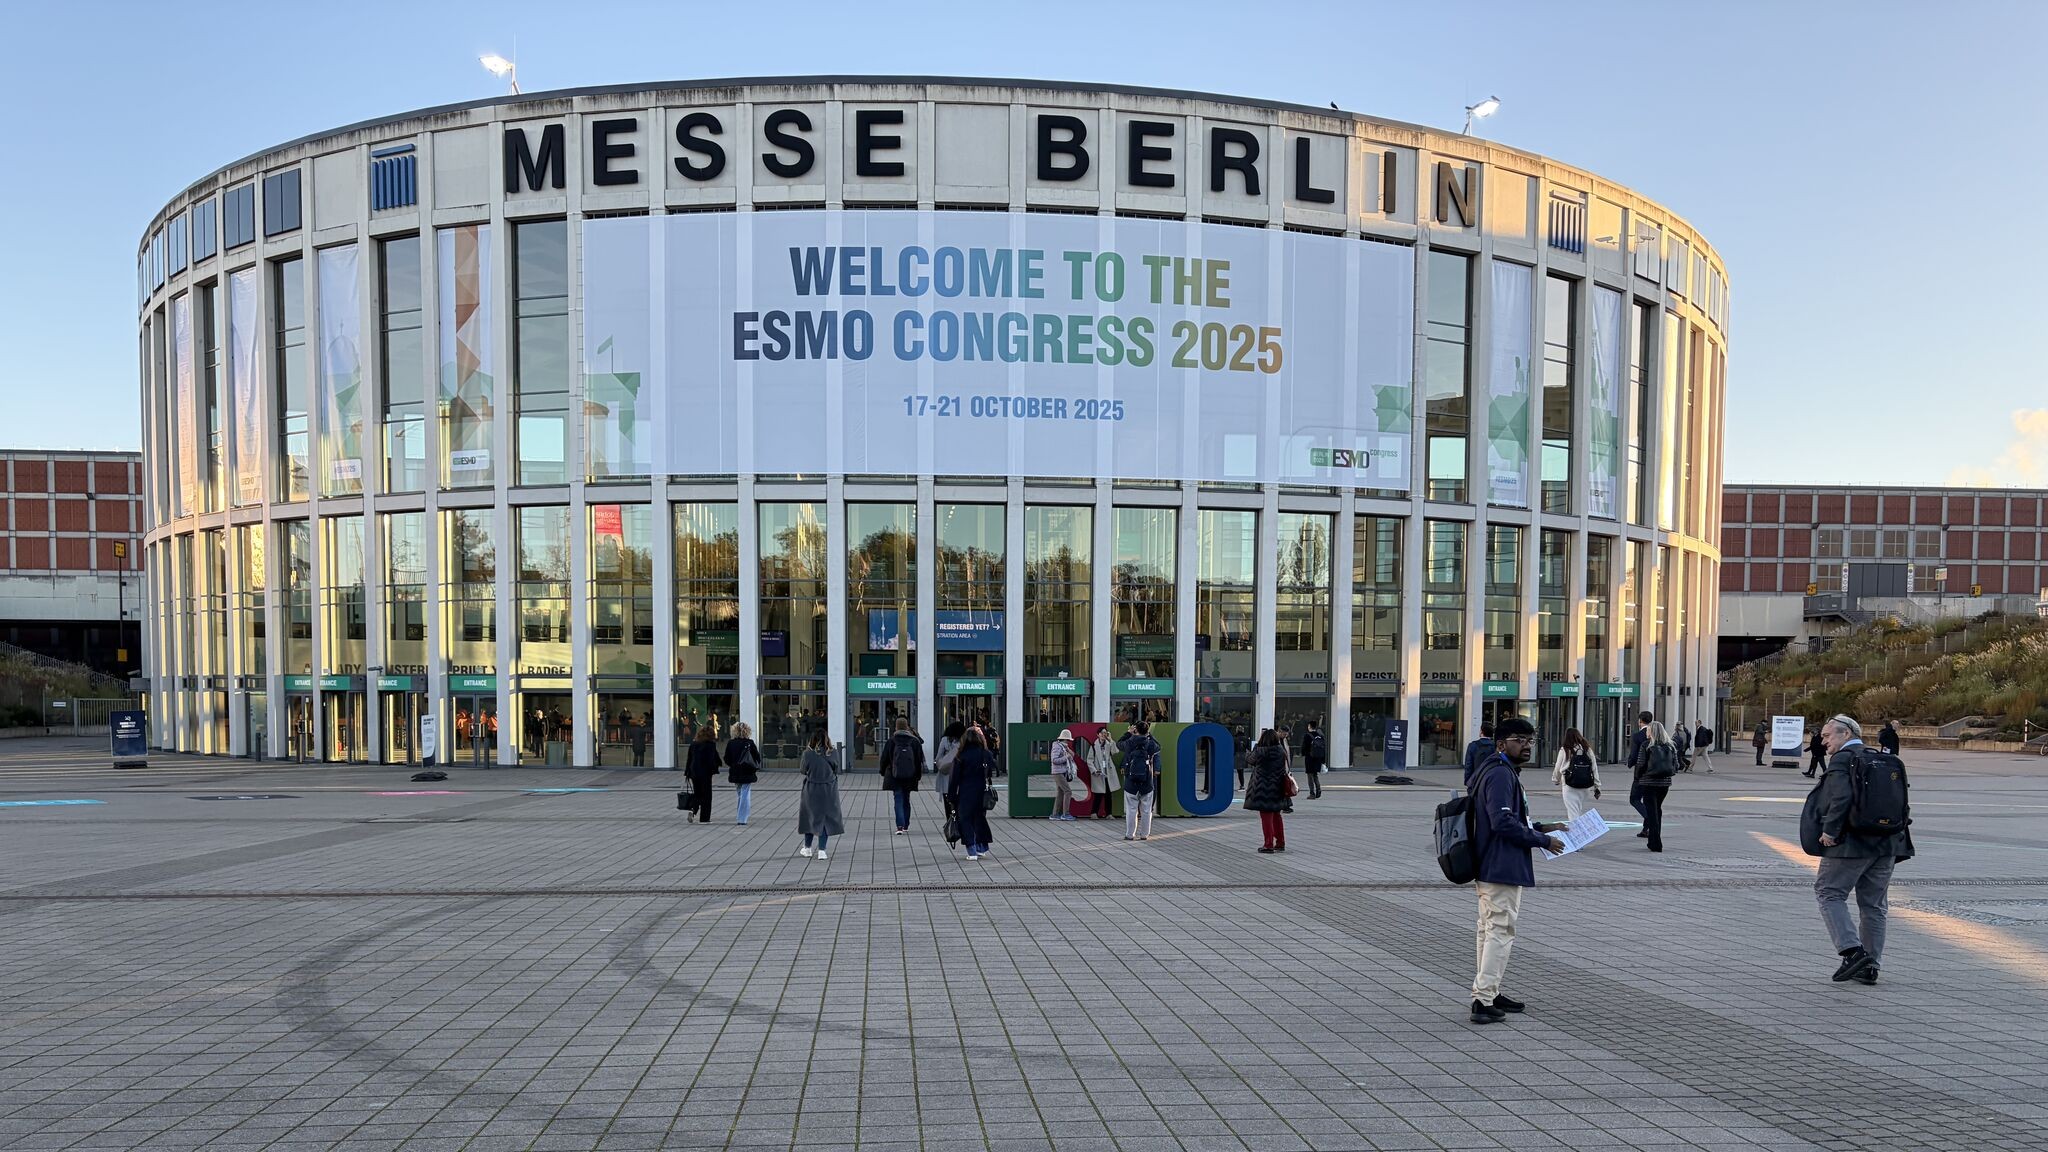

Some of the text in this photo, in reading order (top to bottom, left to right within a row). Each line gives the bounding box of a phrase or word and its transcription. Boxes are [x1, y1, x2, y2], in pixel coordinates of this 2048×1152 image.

[505, 109, 1477, 228] MESSE BERLIN
[789, 246, 1231, 309] WELCOME TO THE
[733, 310, 1283, 375] ESMO CONGRESS 2025
[903, 396, 1124, 421] 17-21 OCTOBER 2025
[1332, 449, 1370, 469] ESMO
[528, 666, 566, 675] BADGE
[464, 679, 487, 687] ENTRANCE
[1047, 683, 1076, 691] ENTRANCE
